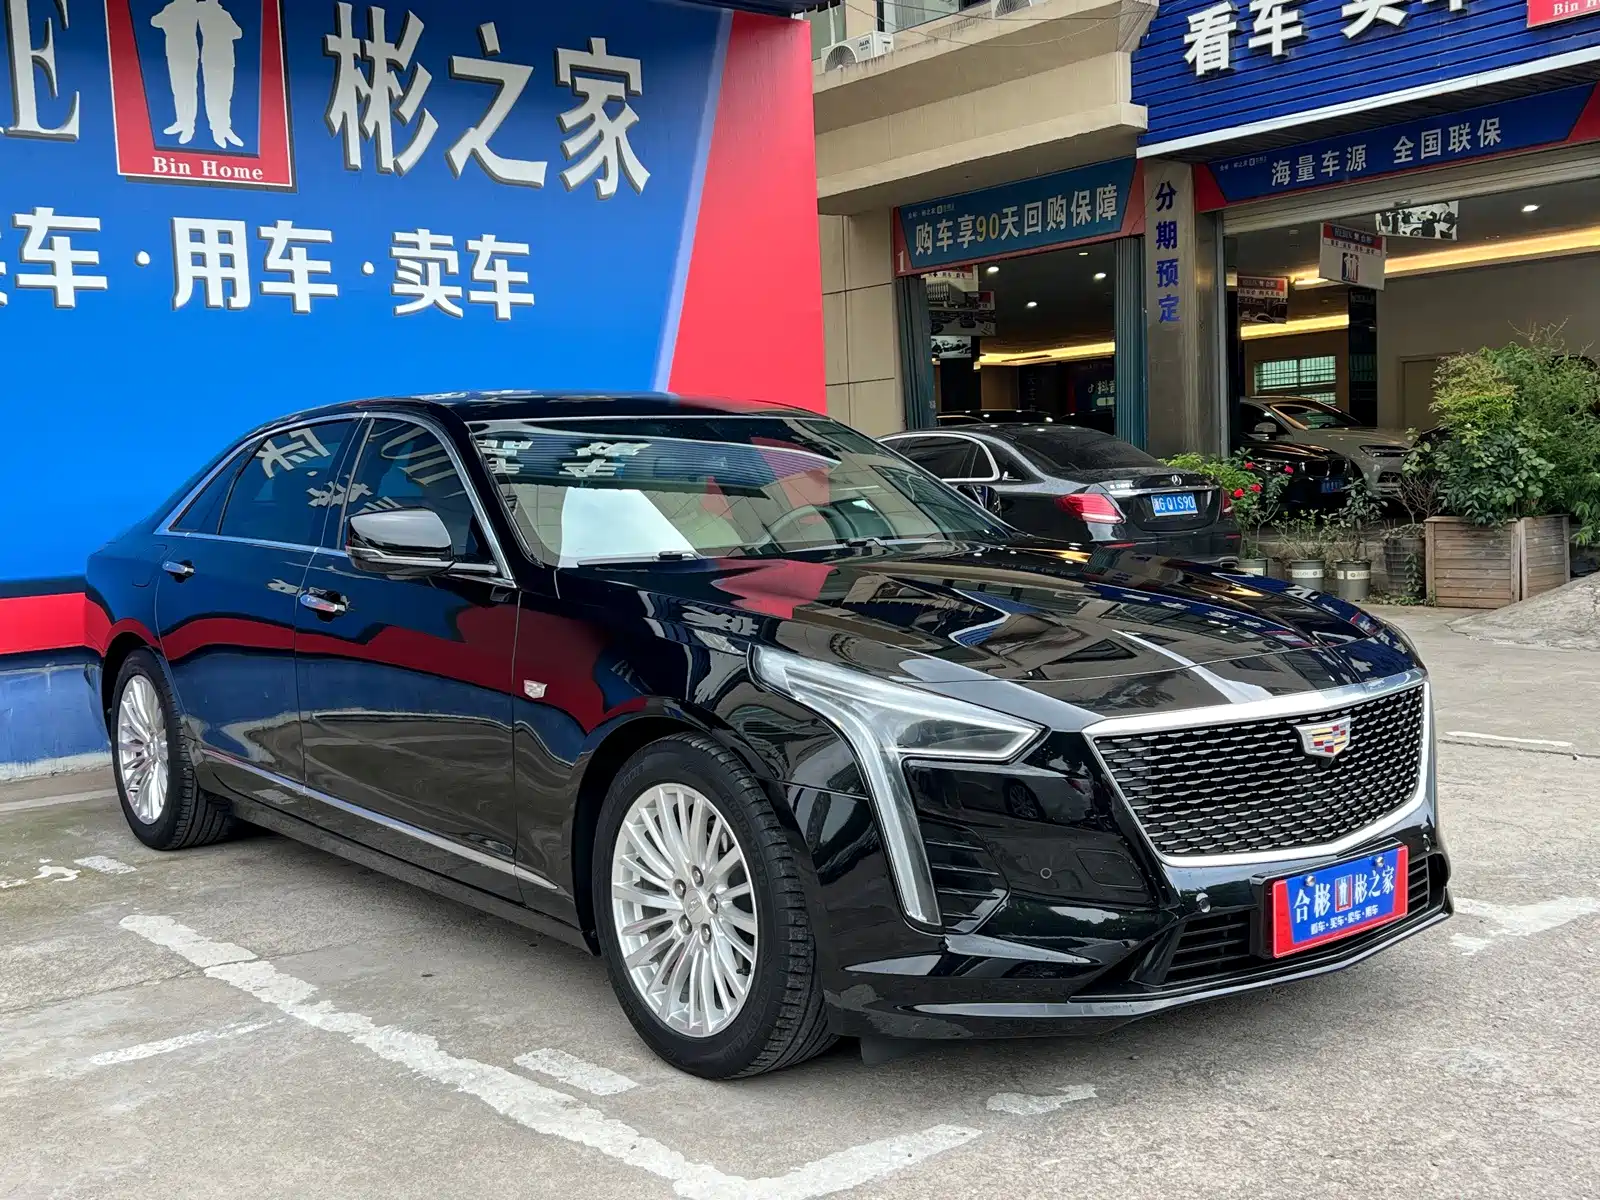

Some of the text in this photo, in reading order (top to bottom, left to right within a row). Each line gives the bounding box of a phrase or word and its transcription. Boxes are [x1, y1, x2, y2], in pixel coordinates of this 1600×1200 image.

[1552, 1, 1579, 17] Bin
[0, 0, 80, 140] E
[324, 2, 651, 199] 彬之家
[151, 155, 263, 181] Bin Home
[1270, 116, 1502, 187] 海量车源 全国联保
[915, 183, 1118, 256] 购车享90天回购保障
[1154, 180, 1181, 324] 分期预定
[1293, 865, 1395, 924] 合彬 彬之家
